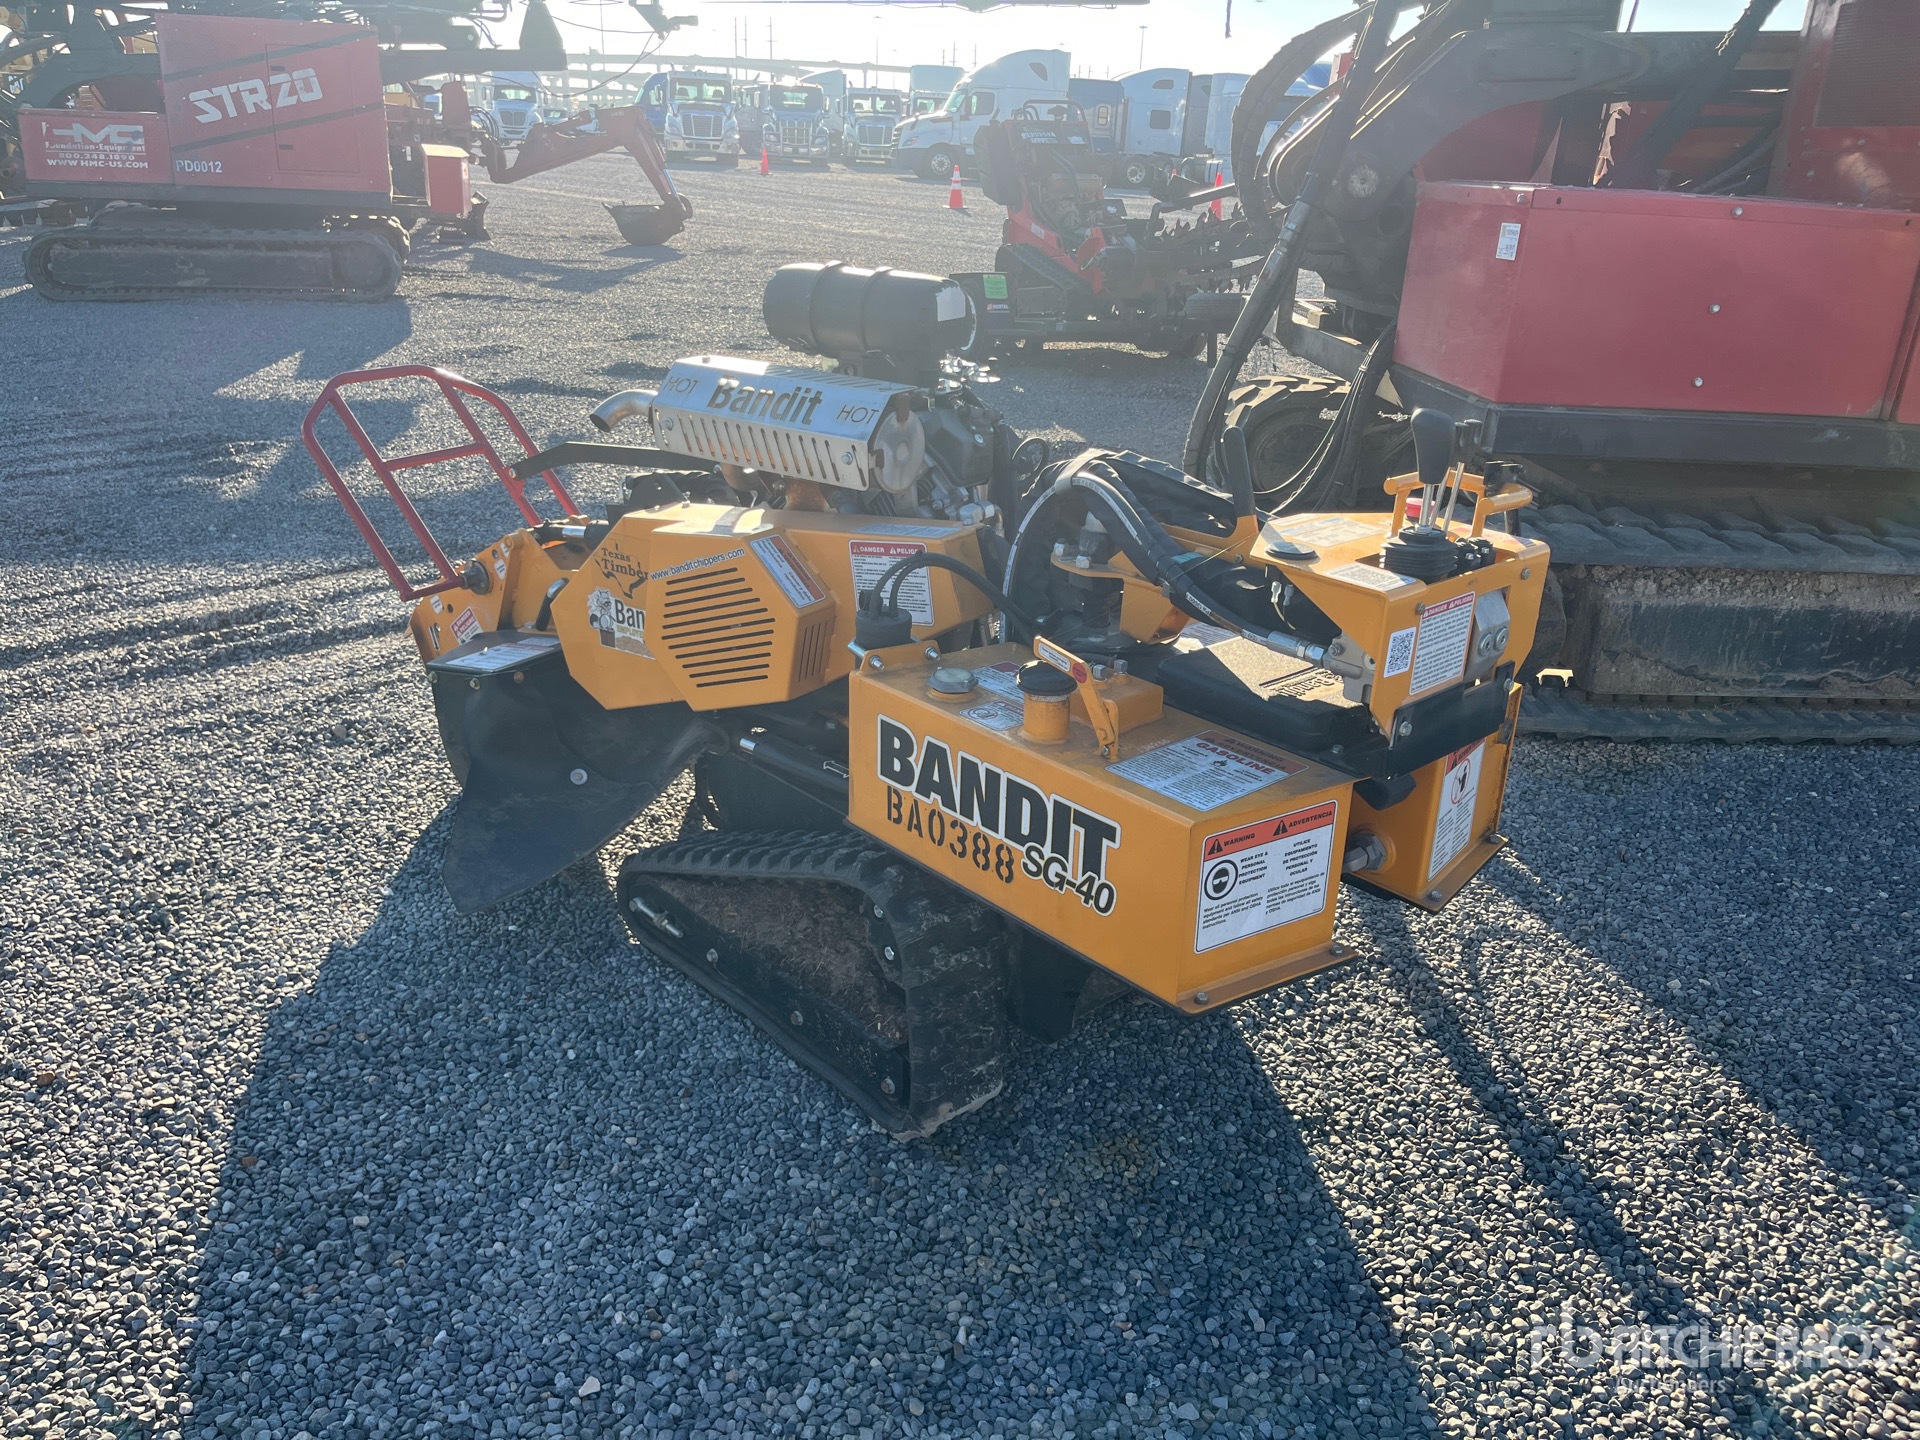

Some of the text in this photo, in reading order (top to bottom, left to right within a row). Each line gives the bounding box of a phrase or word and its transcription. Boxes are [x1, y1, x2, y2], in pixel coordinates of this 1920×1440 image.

[176, 160, 223, 173] PD0012
[663, 376, 701, 395] HOT
[707, 376, 823, 426] Bandit
[836, 403, 880, 425] HOT
[602, 548, 631, 562] Texas
[602, 559, 649, 580] Timber
[650, 548, 745, 580] www.banditchippers.com
[1197, 742, 1275, 775] GASOLINE
[878, 714, 1121, 884] BANDIT
[1289, 811, 1333, 827] ADVERTENCIA
[1224, 833, 1256, 847] WARNING
[1294, 838, 1311, 847] UTILICE
[1285, 843, 1318, 857] EQUIPAMIENTO
[1239, 866, 1267, 878] PROTECTION
[1242, 859, 1265, 870] PERSONAL
[1286, 860, 1308, 870] PERSONAL
[1021, 842, 1117, 917] SG-40
[1239, 873, 1266, 885] EQUIPMENT
